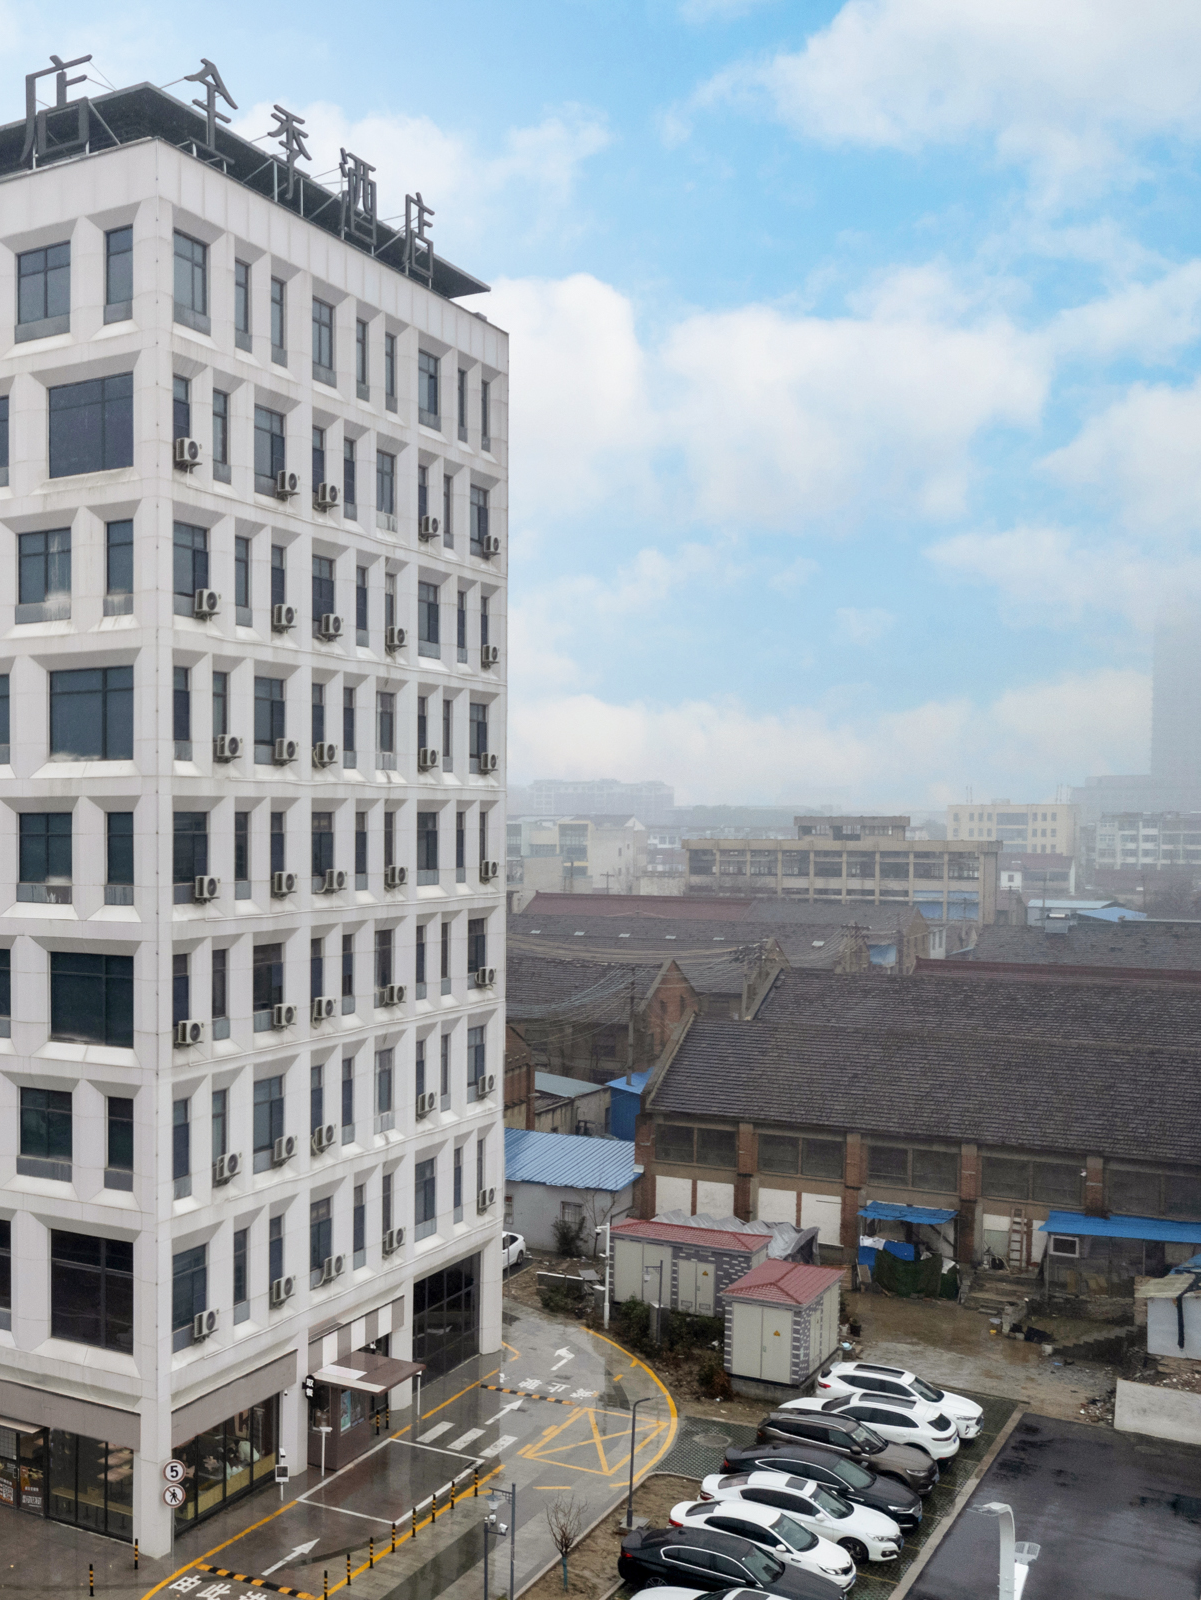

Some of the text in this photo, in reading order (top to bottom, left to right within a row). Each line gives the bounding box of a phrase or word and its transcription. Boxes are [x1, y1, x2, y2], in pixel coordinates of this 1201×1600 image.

[184, 58, 435, 278] 全季酒店
[170, 1465, 179, 1478] 5
